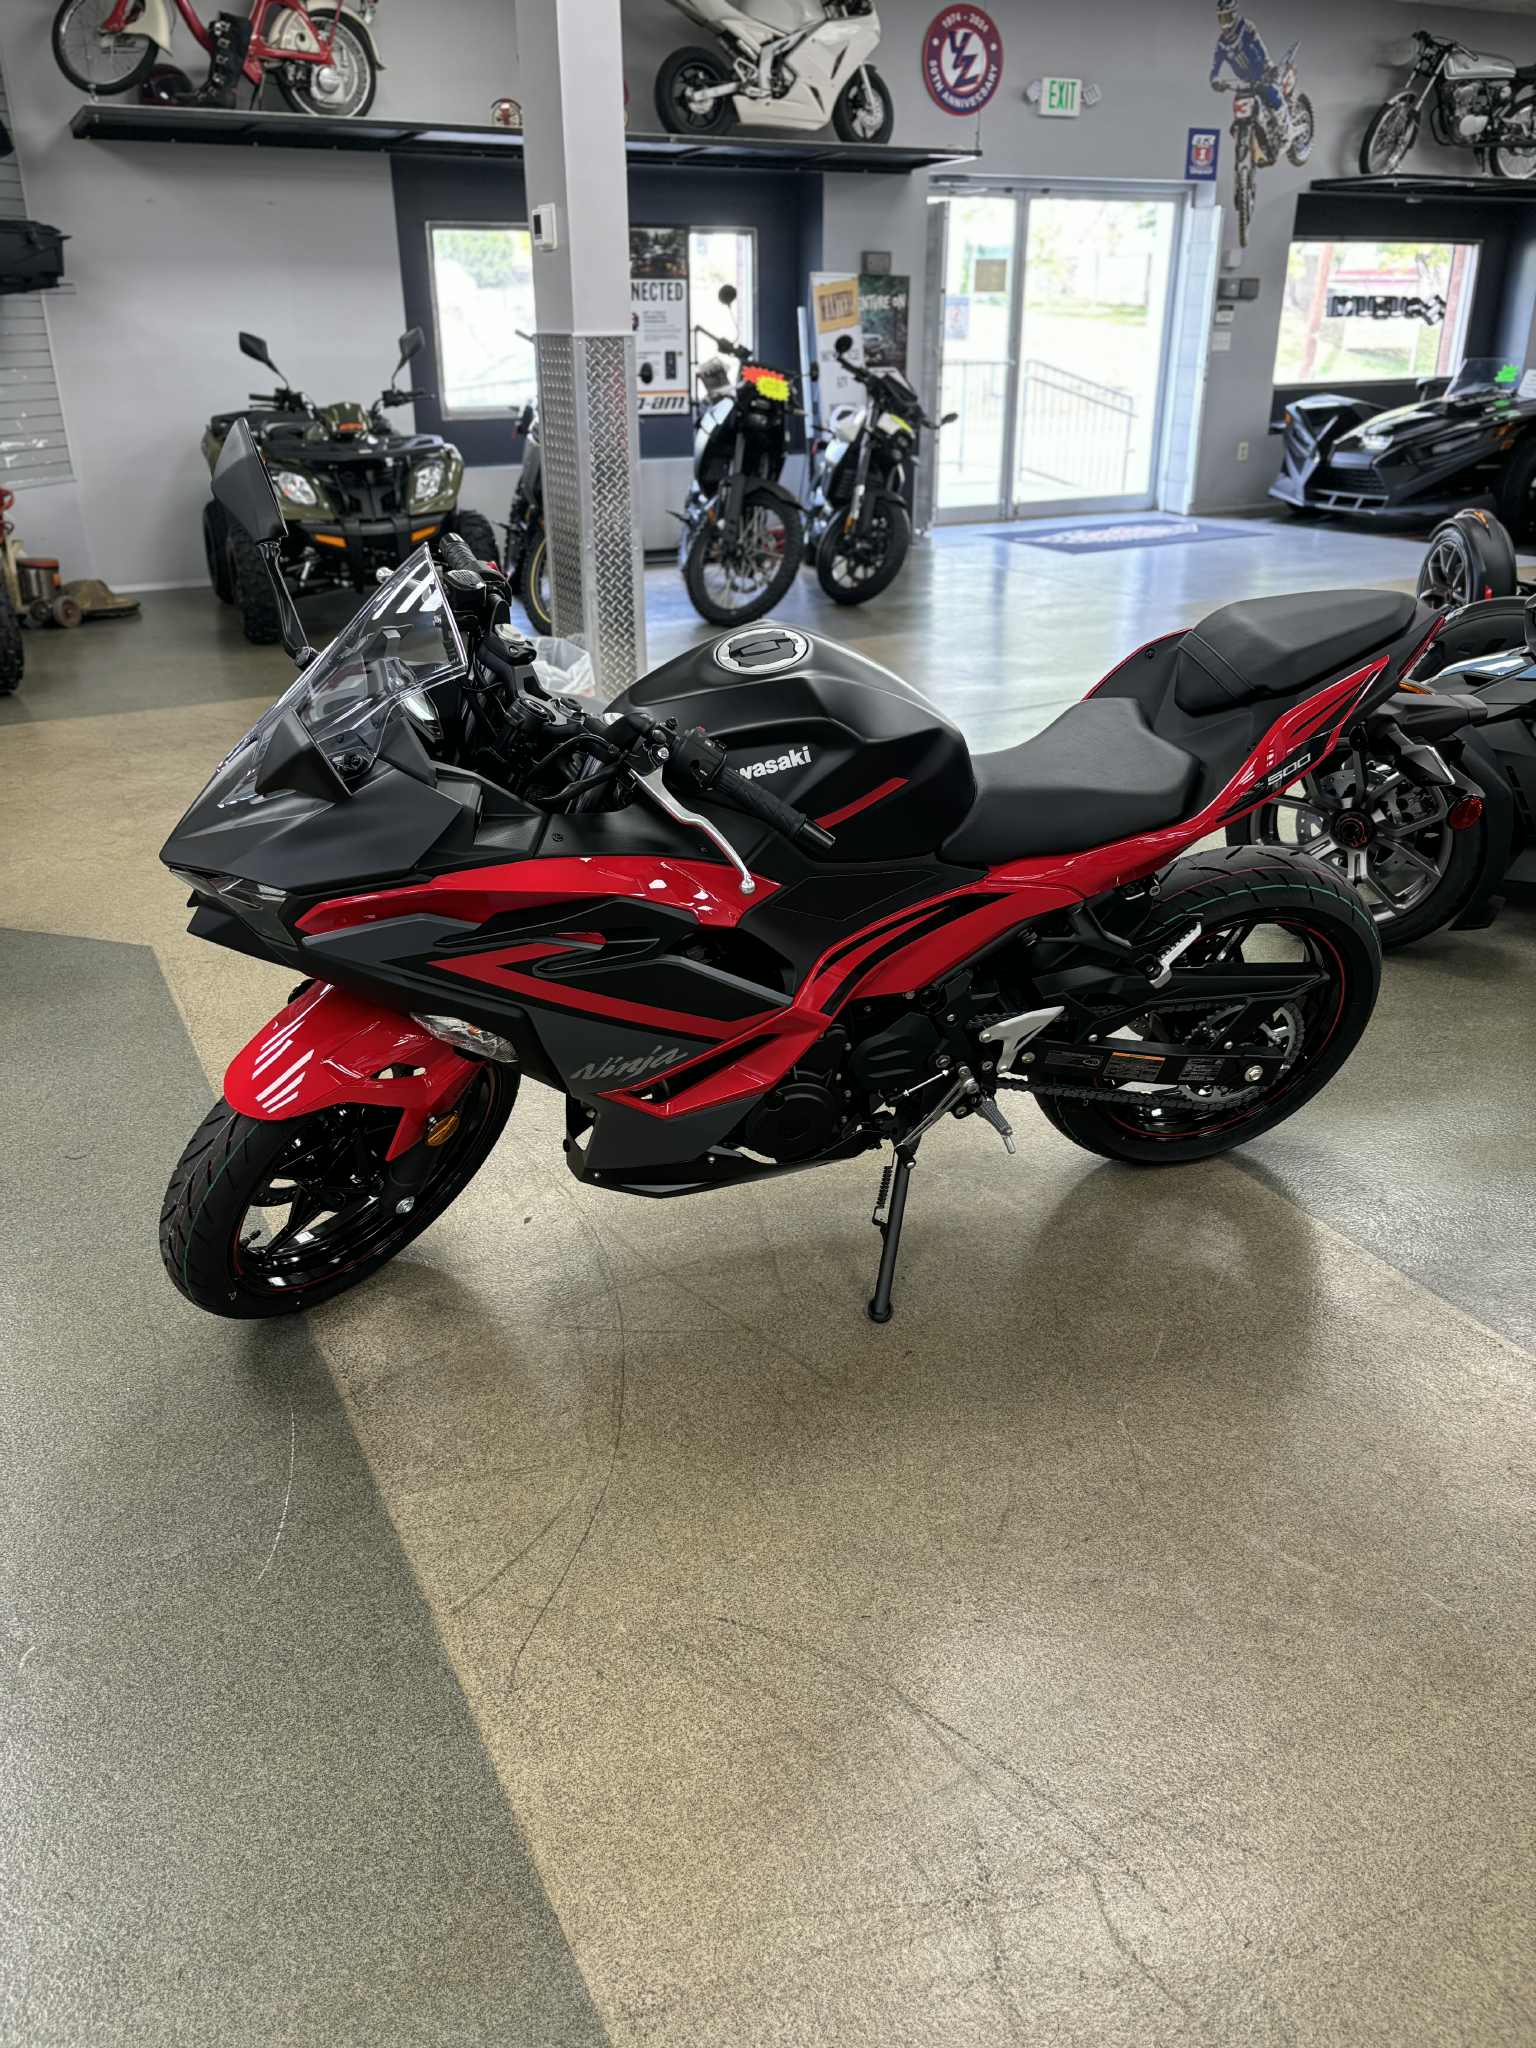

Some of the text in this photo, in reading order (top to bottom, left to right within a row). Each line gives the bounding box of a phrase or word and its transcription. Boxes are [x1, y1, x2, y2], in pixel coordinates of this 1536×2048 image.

[1048, 79, 1077, 110] EXIT
[631, 281, 683, 301] NECTED
[735, 745, 812, 780] wasaki
[1267, 753, 1311, 785] 500
[569, 1045, 688, 1082] Ninja
